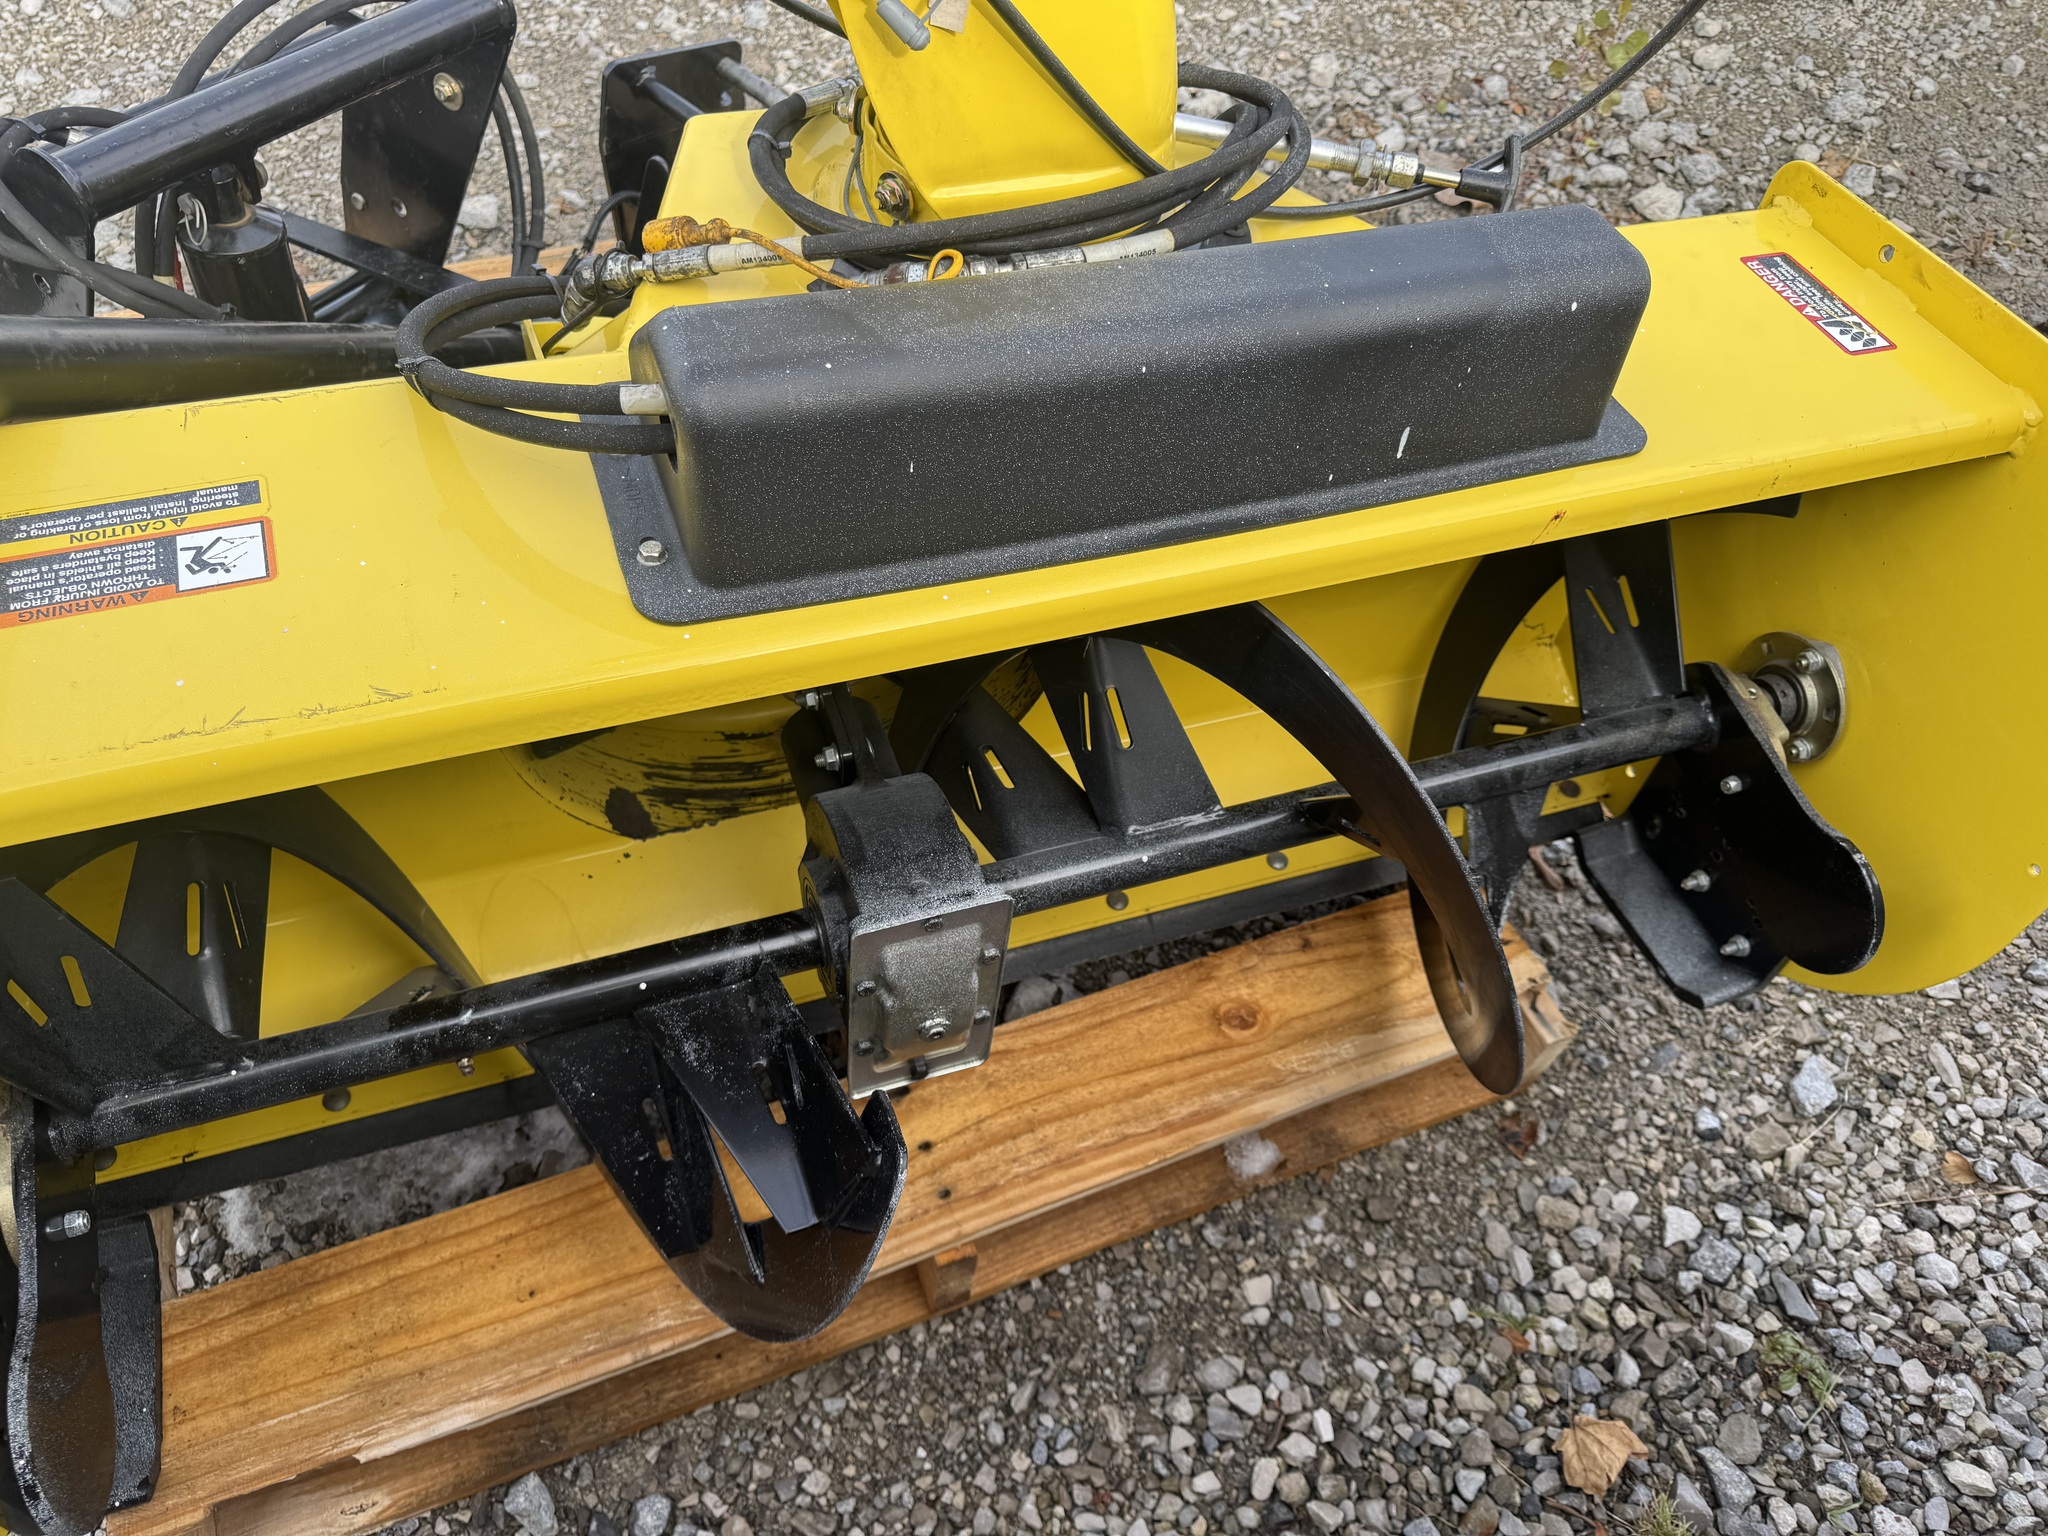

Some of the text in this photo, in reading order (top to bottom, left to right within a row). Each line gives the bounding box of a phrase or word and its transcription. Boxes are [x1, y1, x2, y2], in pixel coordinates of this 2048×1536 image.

[1744, 260, 1806, 305] DANGER
[1800, 295, 1822, 309] aoid
[1817, 309, 1831, 317] To
[188, 490, 238, 505] steering,
[196, 484, 237, 496] manual
[107, 505, 146, 518] ballast
[150, 499, 185, 511] install
[13, 498, 239, 539] To avoid injury from loss of braking or
[19, 514, 81, 531] operator's
[84, 510, 104, 521] per
[69, 519, 165, 544] CAUTION
[68, 540, 154, 560] distance away
[124, 547, 155, 558] Keep
[5, 554, 155, 586] Keep all shields in place
[52, 552, 120, 571] bystanders
[8, 562, 155, 594] Read operator's manual
[10, 567, 37, 577] safe
[9, 577, 164, 610] TO AVOID INJURY FROM
[25, 572, 149, 599] THROWN OBJECTS
[18, 594, 125, 622] WARNING
